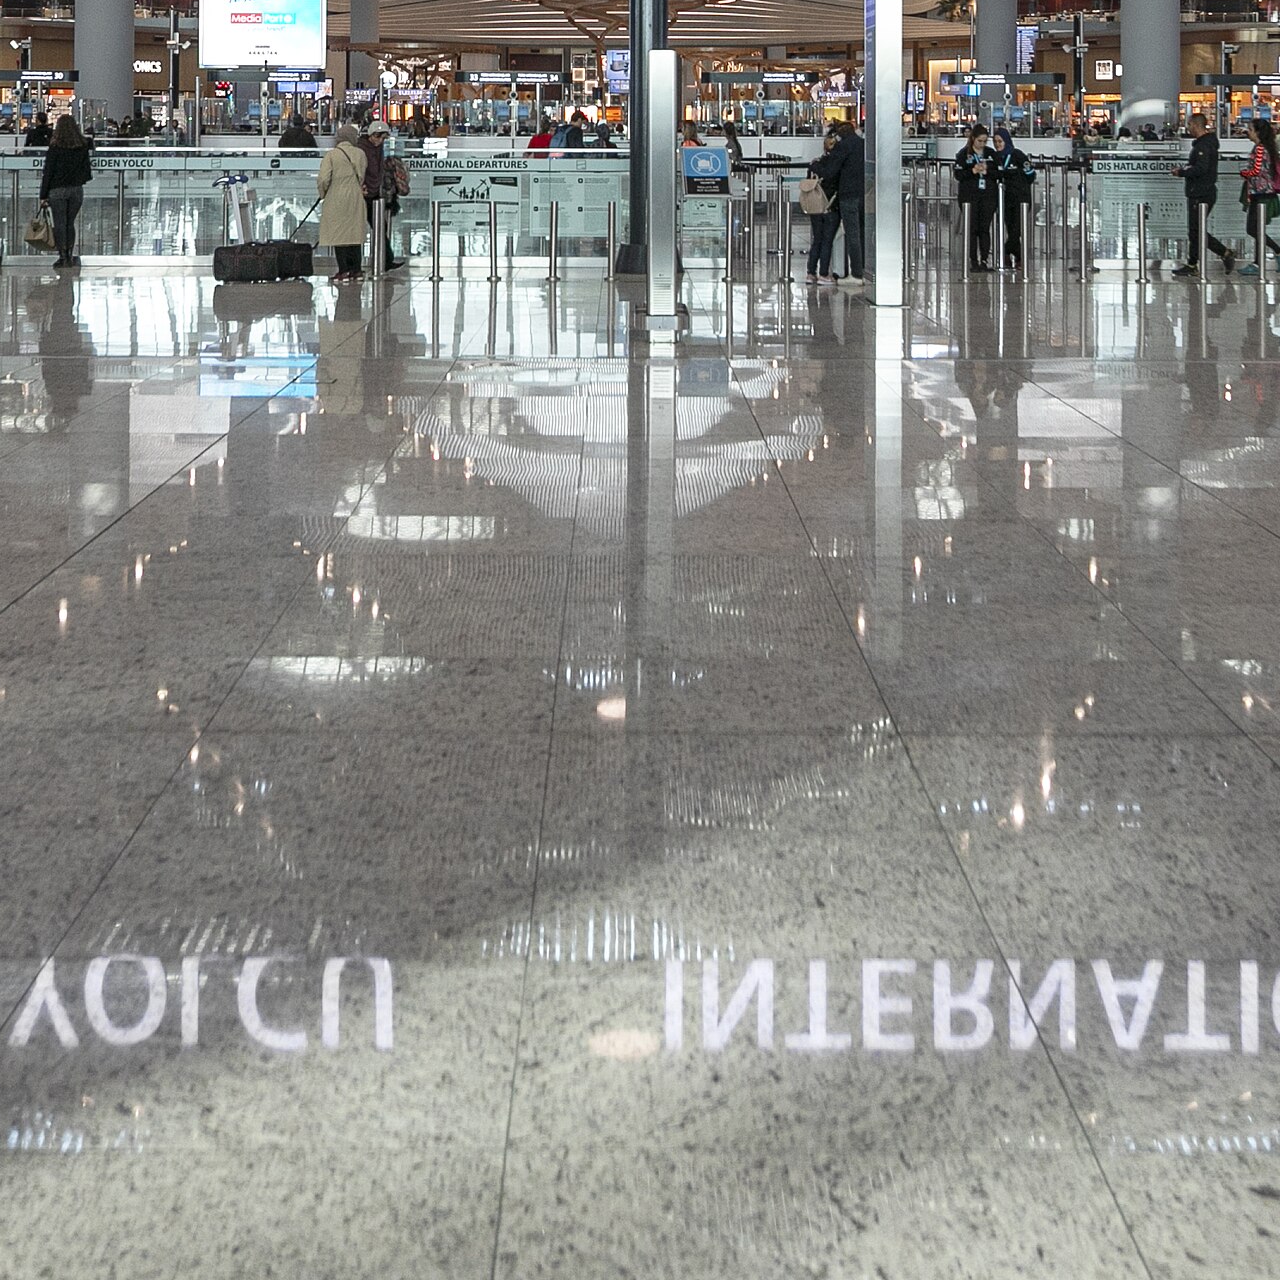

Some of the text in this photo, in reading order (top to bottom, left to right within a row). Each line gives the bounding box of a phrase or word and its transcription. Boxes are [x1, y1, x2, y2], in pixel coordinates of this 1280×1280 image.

[231, 13, 262, 23] Media
[53, 72, 64, 80] 30
[301, 73, 311, 81] 32
[549, 74, 559, 82] 34
[795, 73, 805, 82] 36
[963, 75, 973, 84] 37
[32, 159, 44, 168] DI
[122, 159, 154, 168] YOLCU
[467, 160, 528, 169] DEPARTURES
[1097, 162, 1111, 172] DIŞ
[1113, 162, 1148, 171] HATLAR
